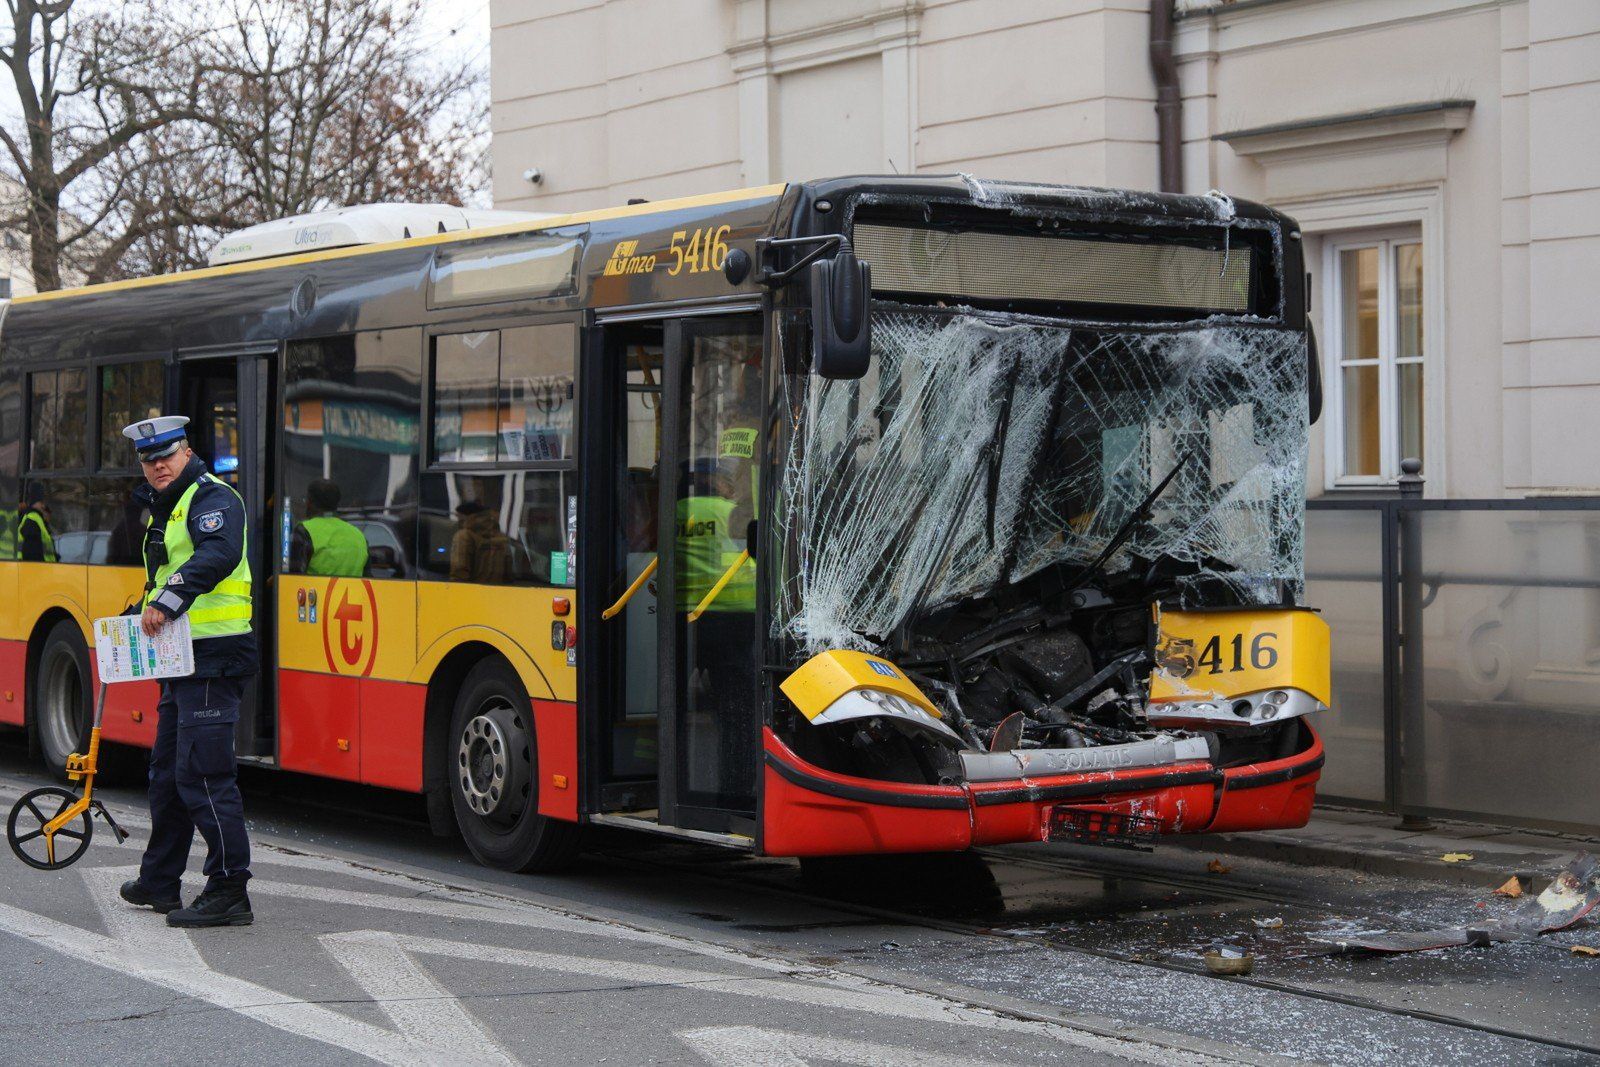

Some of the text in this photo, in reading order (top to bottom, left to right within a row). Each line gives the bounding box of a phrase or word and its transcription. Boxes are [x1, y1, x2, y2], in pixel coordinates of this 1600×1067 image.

[667, 224, 731, 276] 5416
[1169, 632, 1278, 679] 5416
[193, 709, 221, 719] POLICJA
[1058, 748, 1134, 771] SOLARIS
